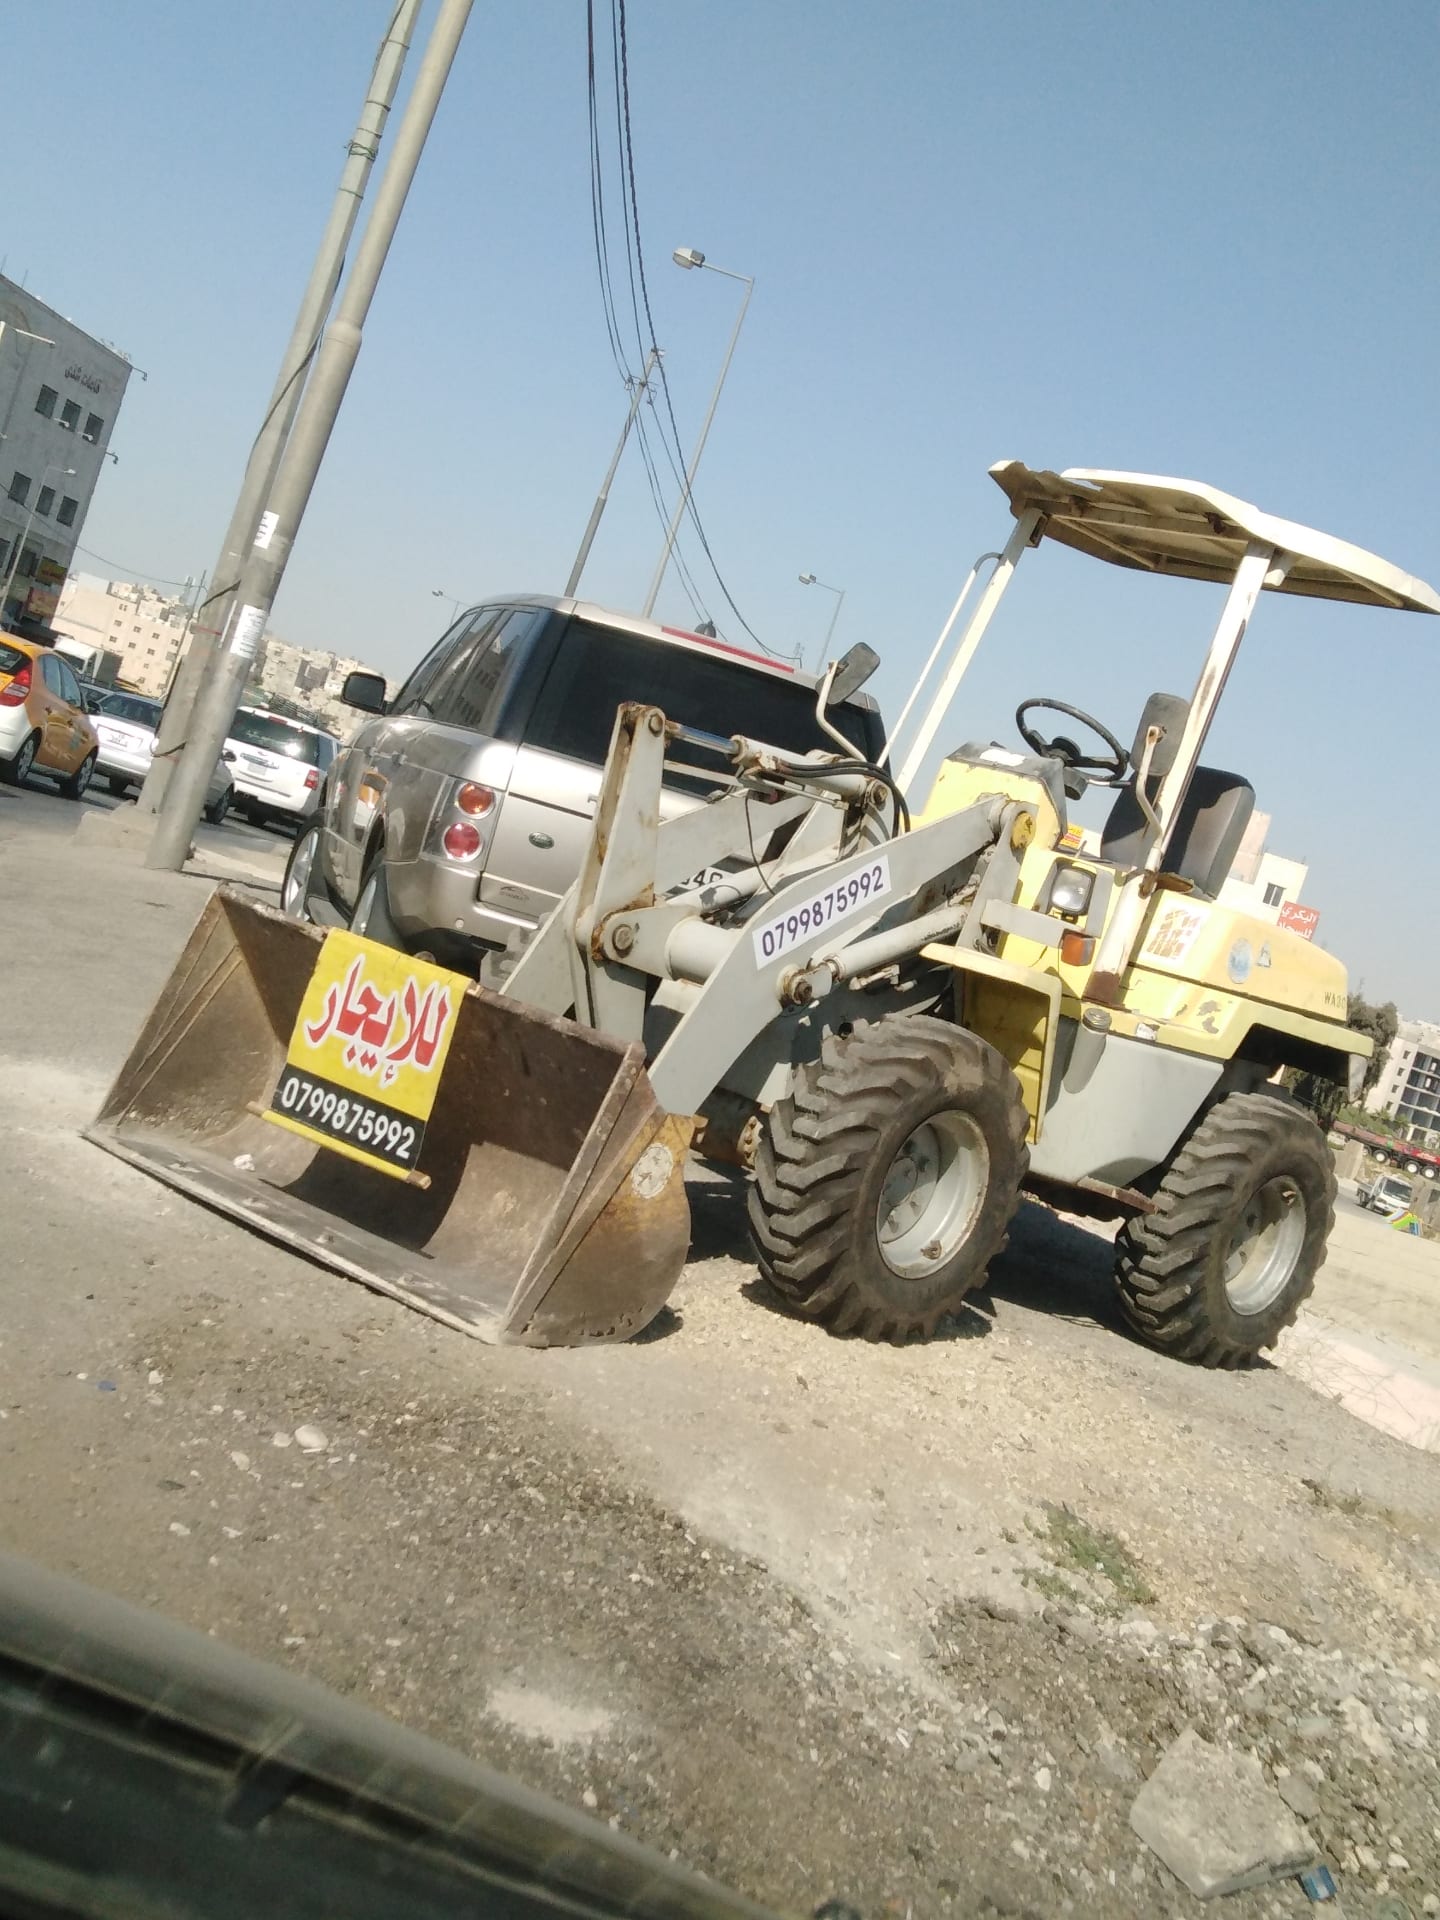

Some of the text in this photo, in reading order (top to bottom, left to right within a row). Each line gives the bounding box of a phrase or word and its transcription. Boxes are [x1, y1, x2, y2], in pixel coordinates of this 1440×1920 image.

[761, 865, 884, 957] 0799875992
[1282, 906, 1317, 924] البكري
[305, 958, 450, 1086] للإيجار
[281, 1077, 416, 1160] 0799875992
